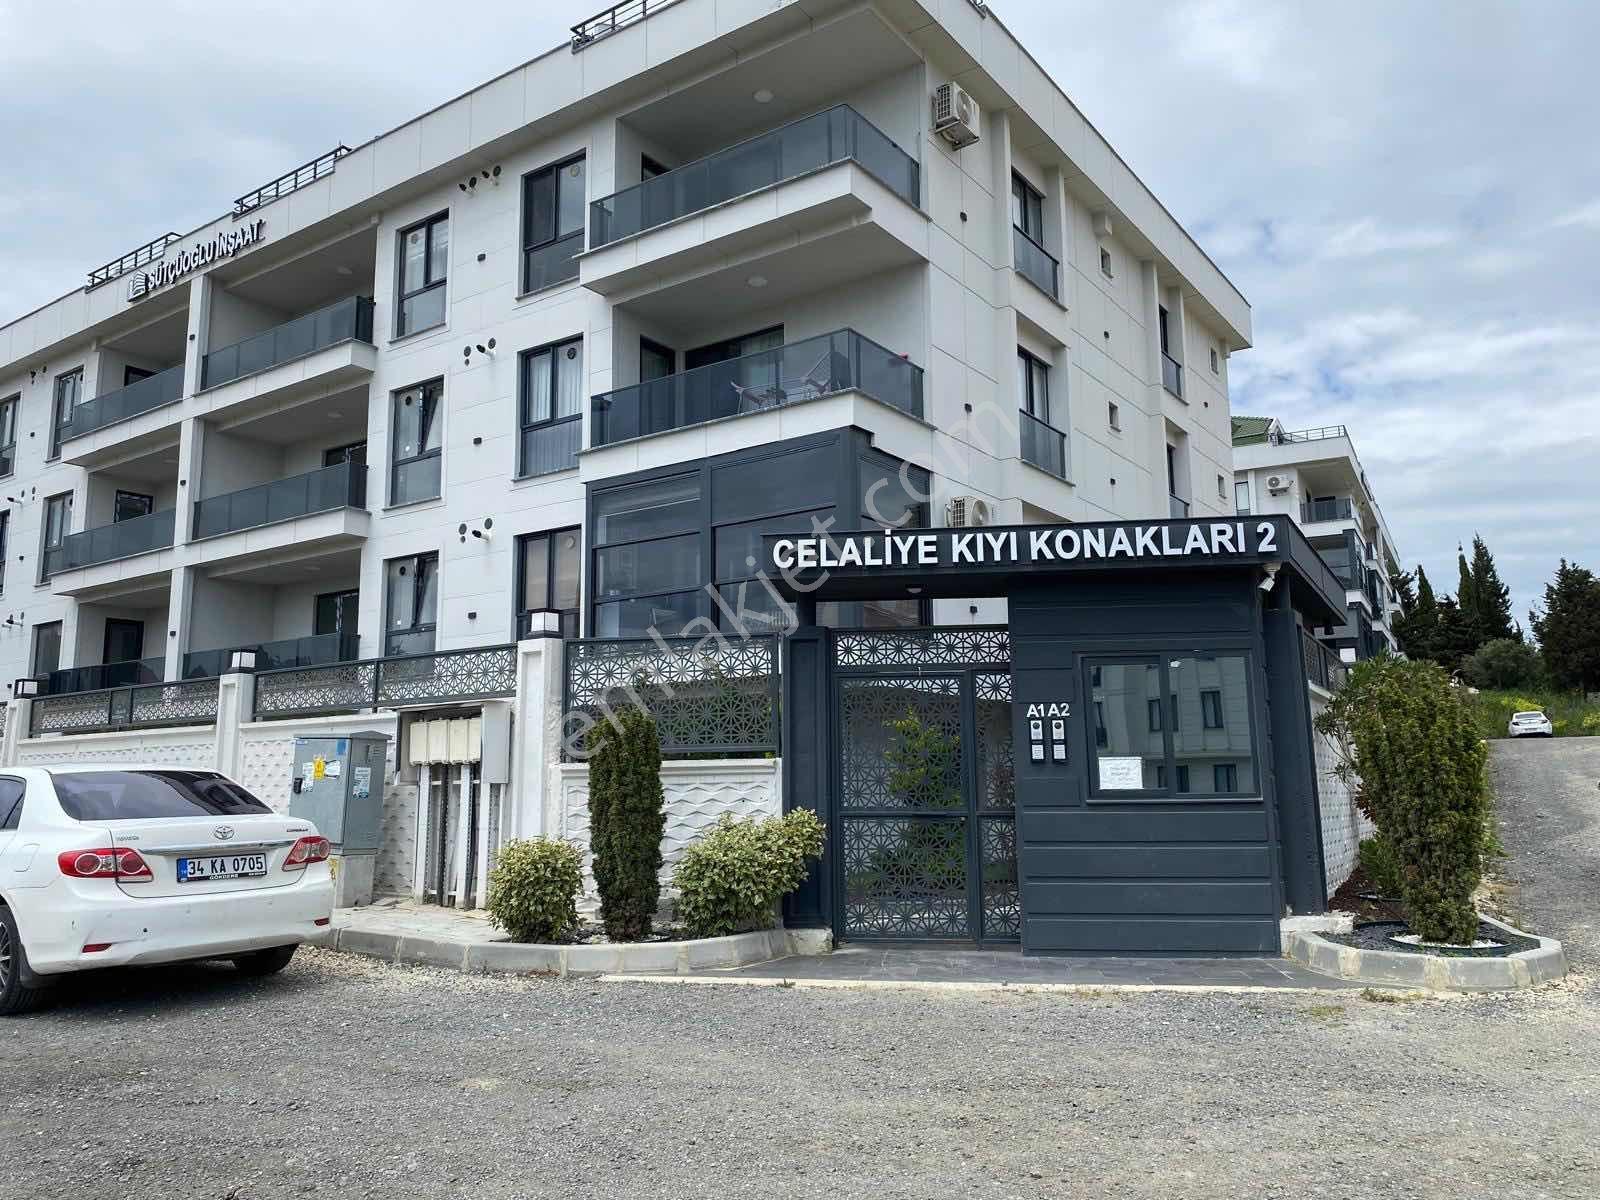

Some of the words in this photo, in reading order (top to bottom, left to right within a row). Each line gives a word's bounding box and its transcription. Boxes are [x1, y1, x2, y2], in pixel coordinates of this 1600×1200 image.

[214, 219, 265, 257] İNŞAAT
[773, 529, 938, 568] CELALİYE
[951, 531, 1018, 563] KIYI
[1029, 522, 1246, 560] KONAKLARI
[1256, 522, 1277, 553] 2
[1026, 703, 1045, 718] A1
[1047, 702, 1071, 718] A2
[188, 861, 204, 875] 34
[210, 859, 226, 873] KA
[232, 856, 263, 872] 0705
